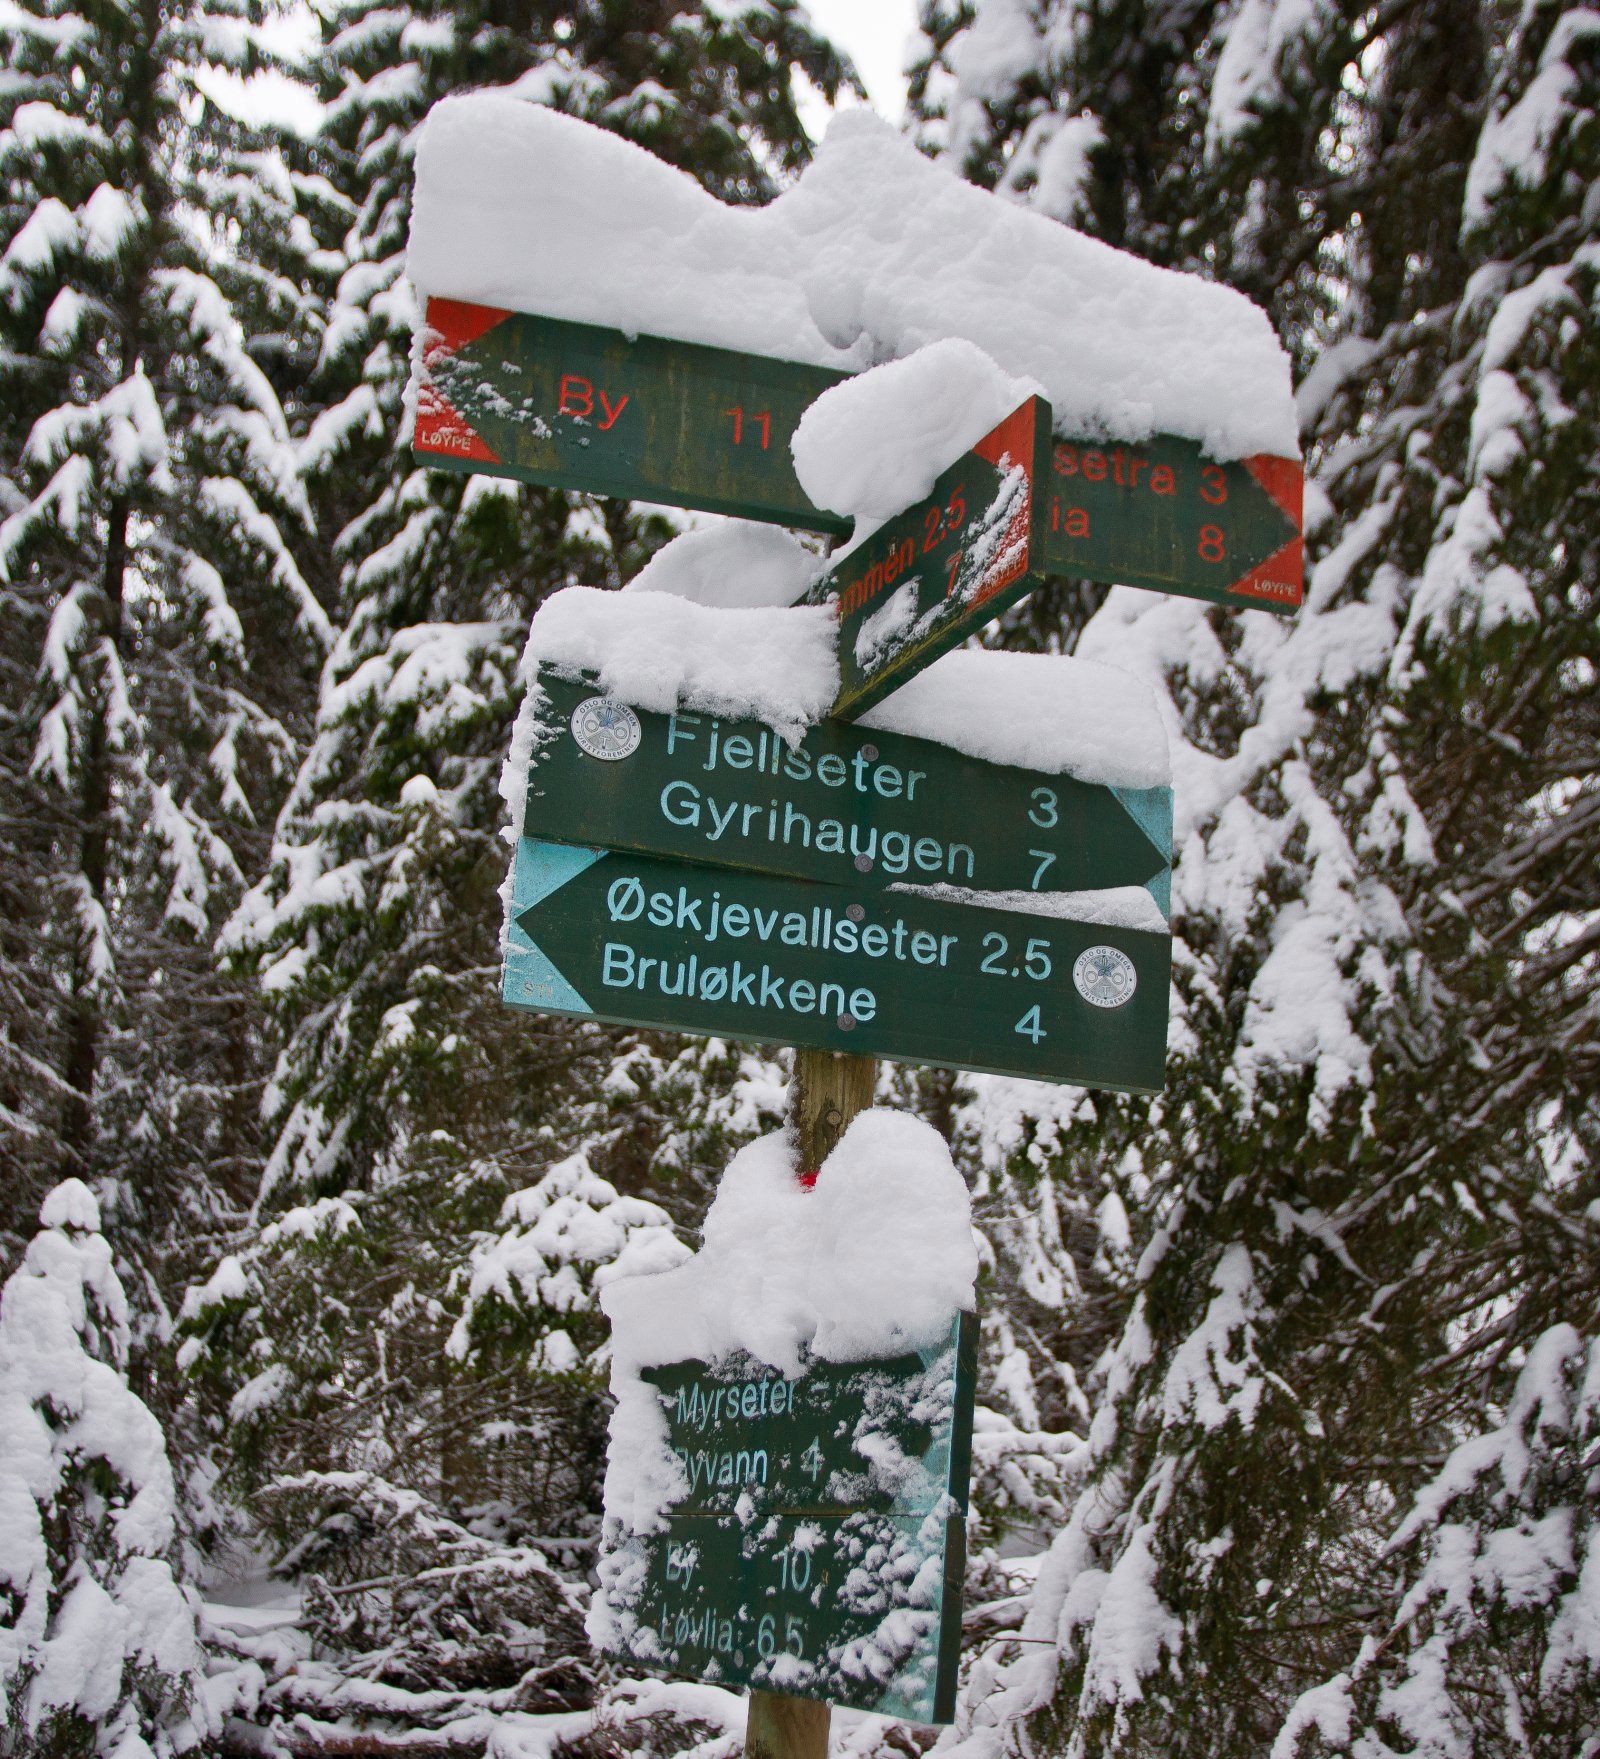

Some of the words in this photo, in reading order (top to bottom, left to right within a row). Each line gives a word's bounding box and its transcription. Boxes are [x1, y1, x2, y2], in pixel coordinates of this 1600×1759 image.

[558, 374, 629, 431] By
[726, 404, 771, 449] 11
[1053, 443, 1176, 496] setra
[1199, 464, 1228, 505] 3
[837, 538, 914, 617] mmen
[1198, 524, 1226, 564] 8
[579, 699, 599, 714] OSLO
[615, 703, 637, 727] OMEGN
[667, 714, 927, 801] Fjellseter
[1028, 786, 1058, 828] 3
[660, 780, 975, 878] Gyrihaugen
[1028, 849, 1056, 890] 7
[607, 876, 958, 967] Øskjevallseter
[602, 942, 877, 1022] Bruløkkene
[1014, 1004, 1047, 1044] 4
[1078, 951, 1094, 967] OSLO
[676, 1372, 801, 1432] Myrseter
[800, 1435, 826, 1483] 4
